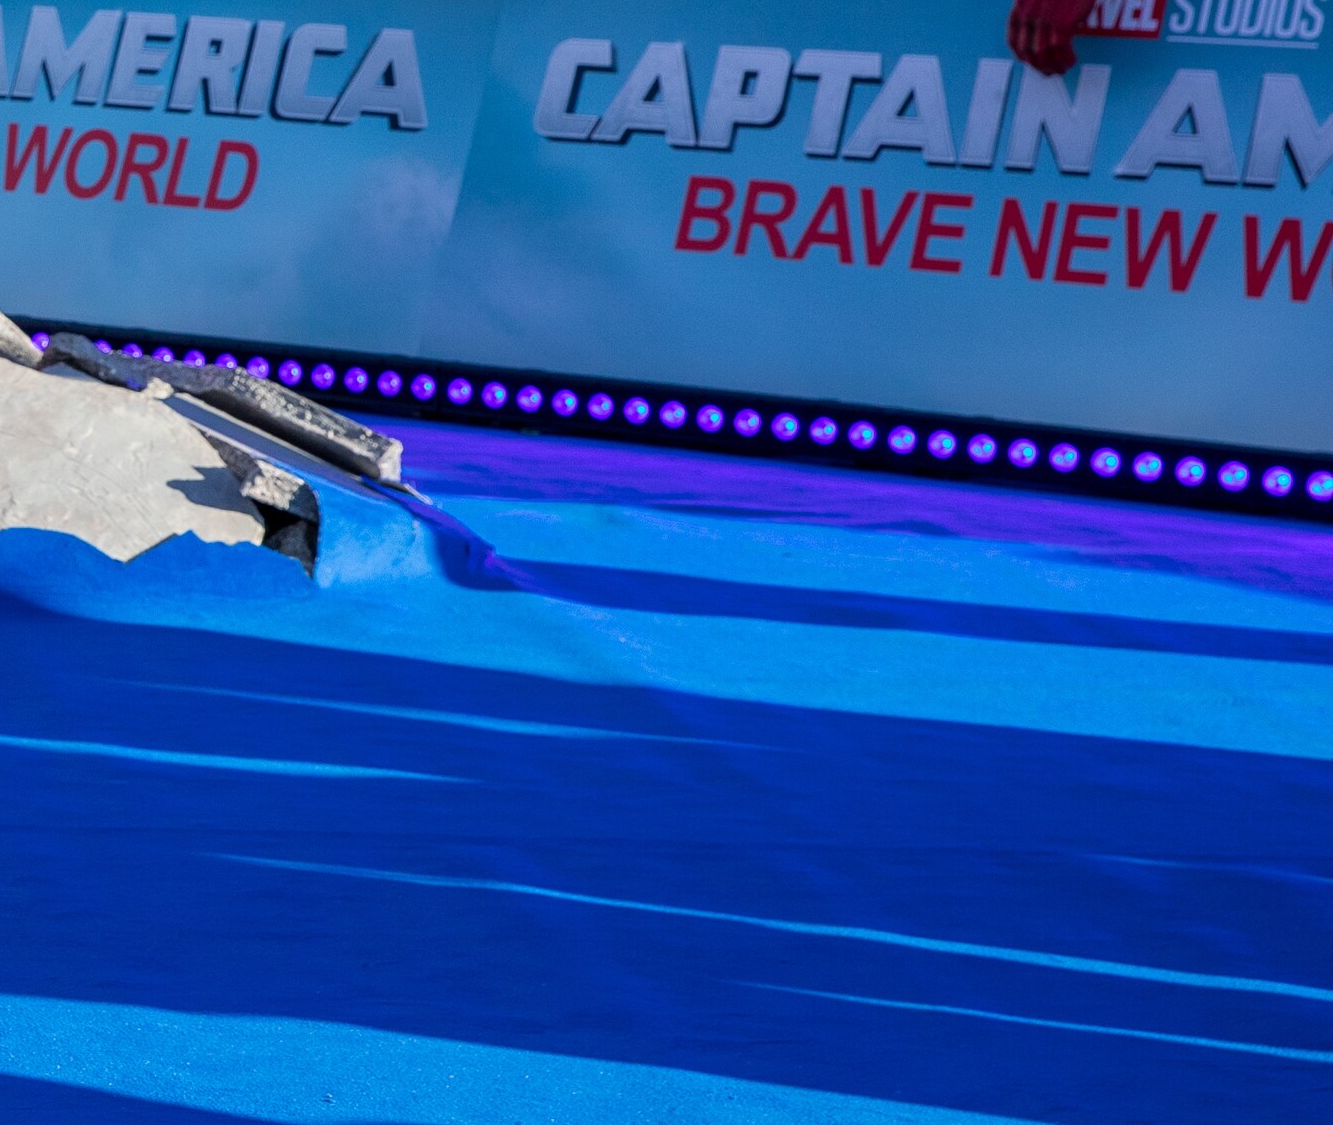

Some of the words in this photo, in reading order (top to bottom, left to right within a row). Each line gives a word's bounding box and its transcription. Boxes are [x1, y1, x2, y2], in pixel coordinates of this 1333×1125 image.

[533, 38, 1112, 177] CAPTAIN
[4, 124, 260, 211] WORLD
[674, 175, 974, 274] BRAVE
[990, 196, 1219, 293] NEW
